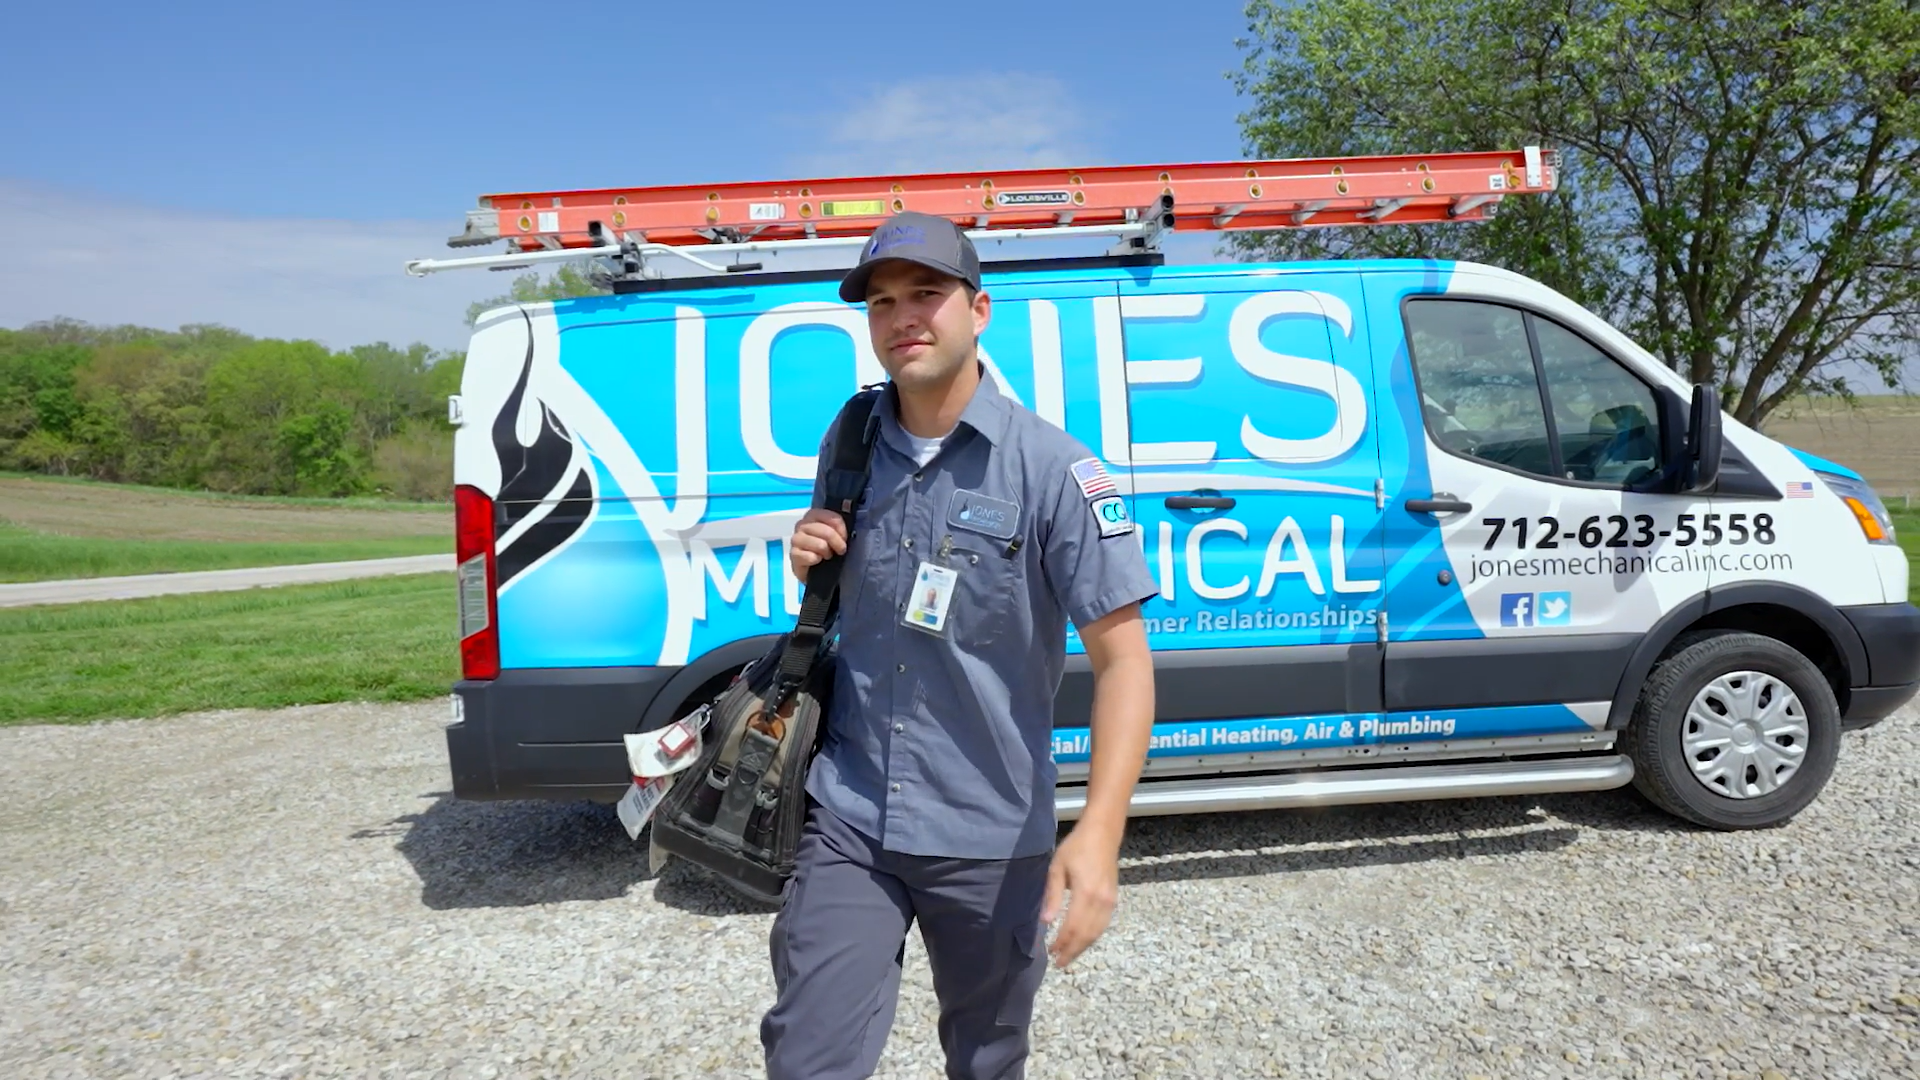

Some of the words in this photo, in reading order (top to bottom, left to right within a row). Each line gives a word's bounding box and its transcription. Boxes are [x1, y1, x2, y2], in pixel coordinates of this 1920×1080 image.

[1010, 194, 1068, 203] LOUISVILLE
[1482, 513, 1776, 550] 712-623-5558
[1469, 549, 1793, 584] jonesmechanicalinc.com
[1197, 604, 1377, 632] Relationships
[1212, 725, 1298, 746] Heating,
[1303, 722, 1335, 740] Air
[1338, 720, 1355, 738] &
[1359, 715, 1456, 737] Plumbing
